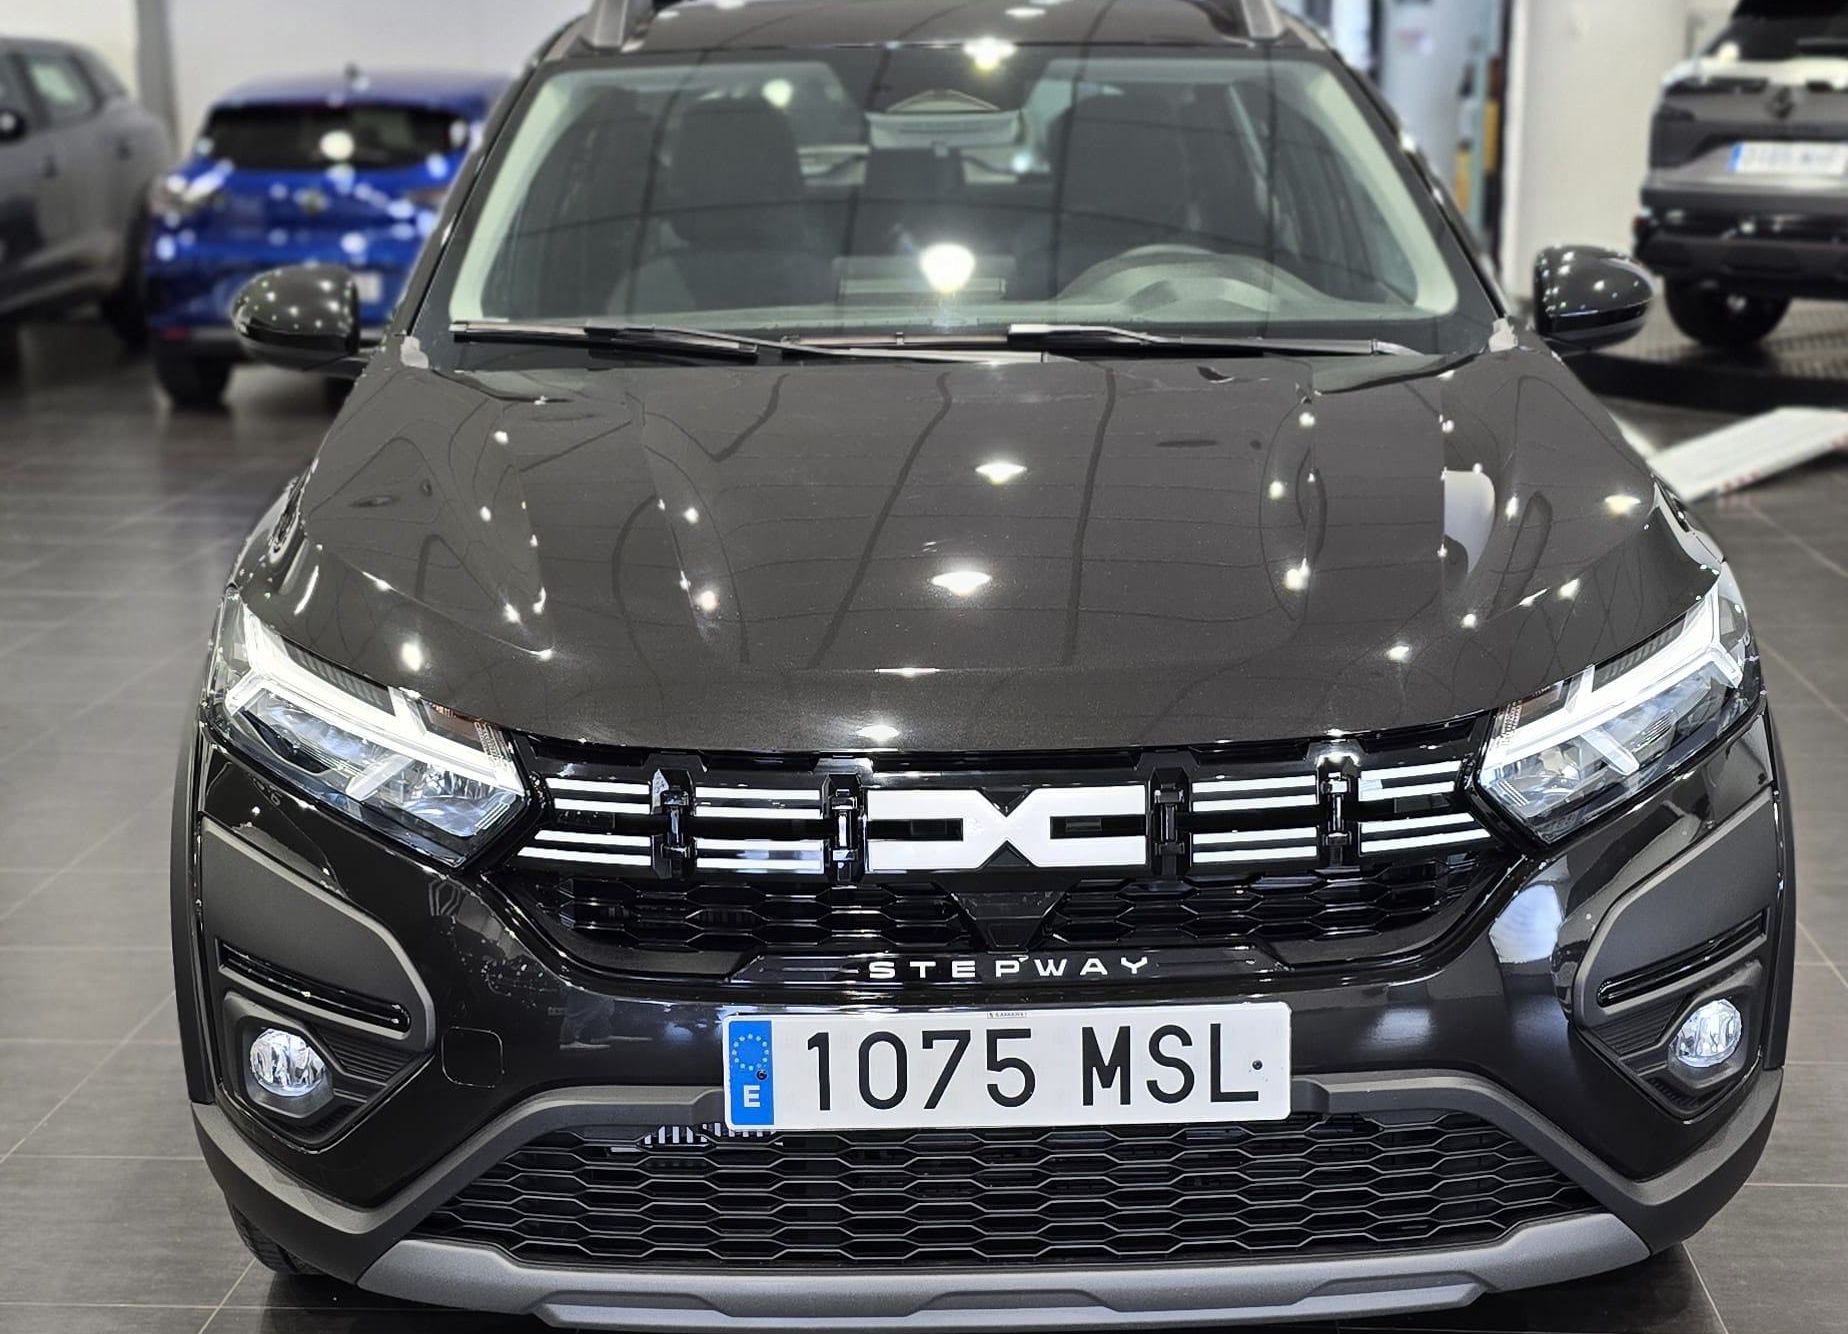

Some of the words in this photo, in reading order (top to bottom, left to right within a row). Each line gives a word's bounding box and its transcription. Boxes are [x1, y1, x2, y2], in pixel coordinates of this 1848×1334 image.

[867, 956, 1149, 979] STEPWAY
[807, 1028, 1036, 1111] 1075
[1081, 1022, 1260, 1107] MSL
[743, 1084, 761, 1108] E
